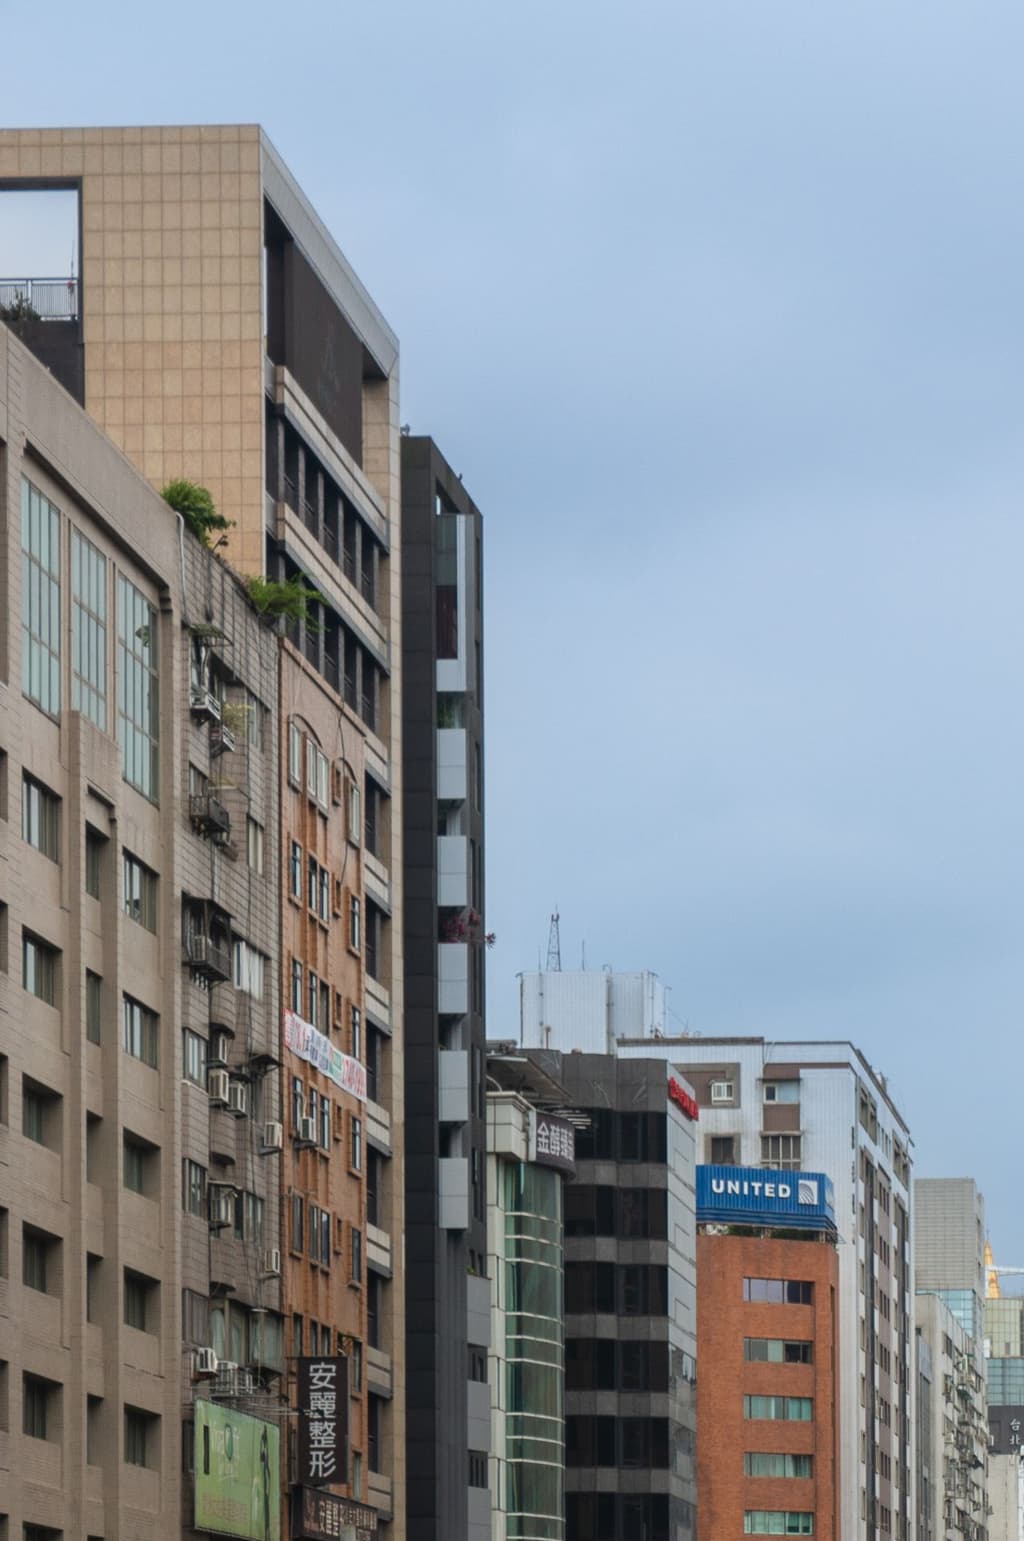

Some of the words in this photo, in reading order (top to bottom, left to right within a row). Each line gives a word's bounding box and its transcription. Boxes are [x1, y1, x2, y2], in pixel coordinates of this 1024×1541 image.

[711, 1179, 791, 1198] UNITED
[309, 1362, 336, 1478] 安麗整形
